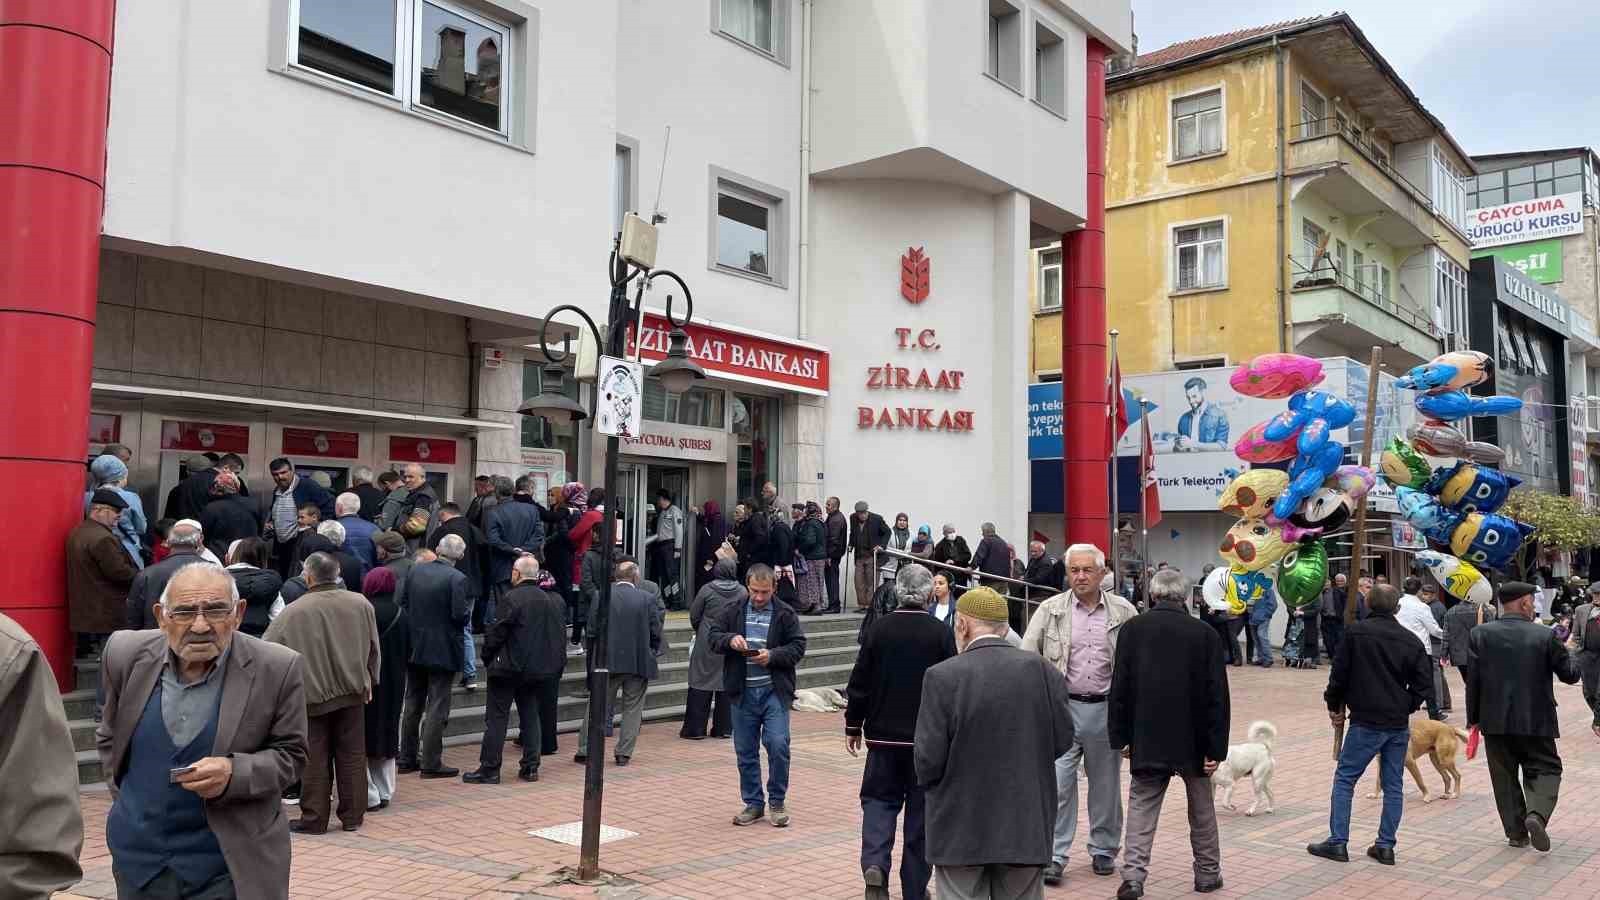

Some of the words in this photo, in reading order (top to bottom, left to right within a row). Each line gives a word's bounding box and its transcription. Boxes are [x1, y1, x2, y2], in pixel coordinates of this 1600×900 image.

[1478, 199, 1564, 225] ÇAYCUMA
[1528, 212, 1581, 231] KURSU
[895, 327, 941, 350] T.C.
[639, 324, 727, 363] ZİAAT
[731, 344, 819, 379] BANKASI
[866, 362, 964, 390] ZİRAAT
[857, 406, 975, 432] BANKASI
[1033, 415, 1064, 426] yepy
[1158, 477, 1179, 487] Türk
[1181, 476, 1225, 487] Telekom
